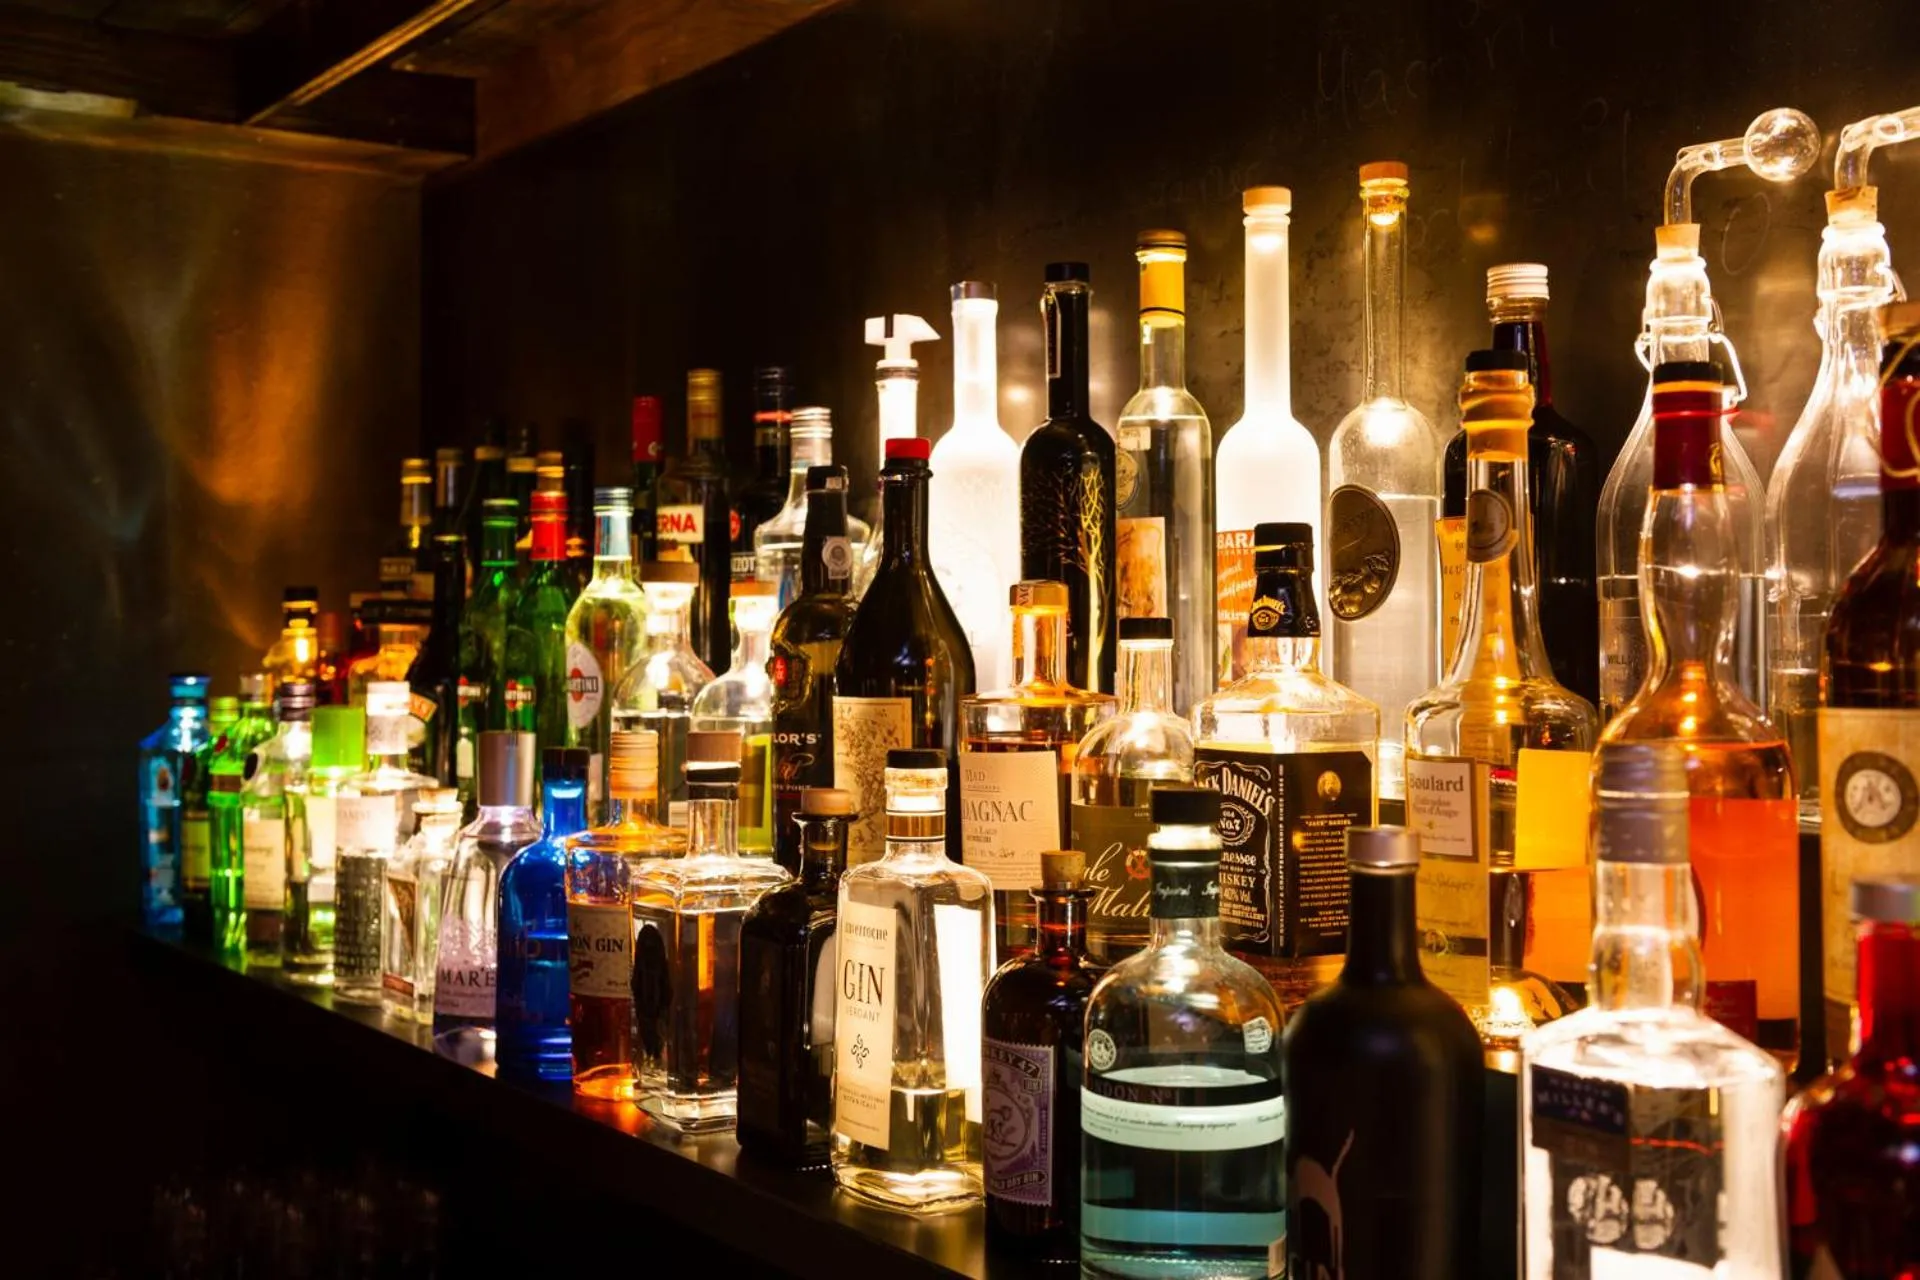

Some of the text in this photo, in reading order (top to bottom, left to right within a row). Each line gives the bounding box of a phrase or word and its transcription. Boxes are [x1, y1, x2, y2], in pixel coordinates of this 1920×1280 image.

[1222, 766, 1276, 817] DANIEL'S
[1409, 774, 1464, 793] Boulard
[595, 937, 625, 953] GIN
[844, 959, 885, 1007] GIN
[1017, 1058, 1037, 1075] 47
